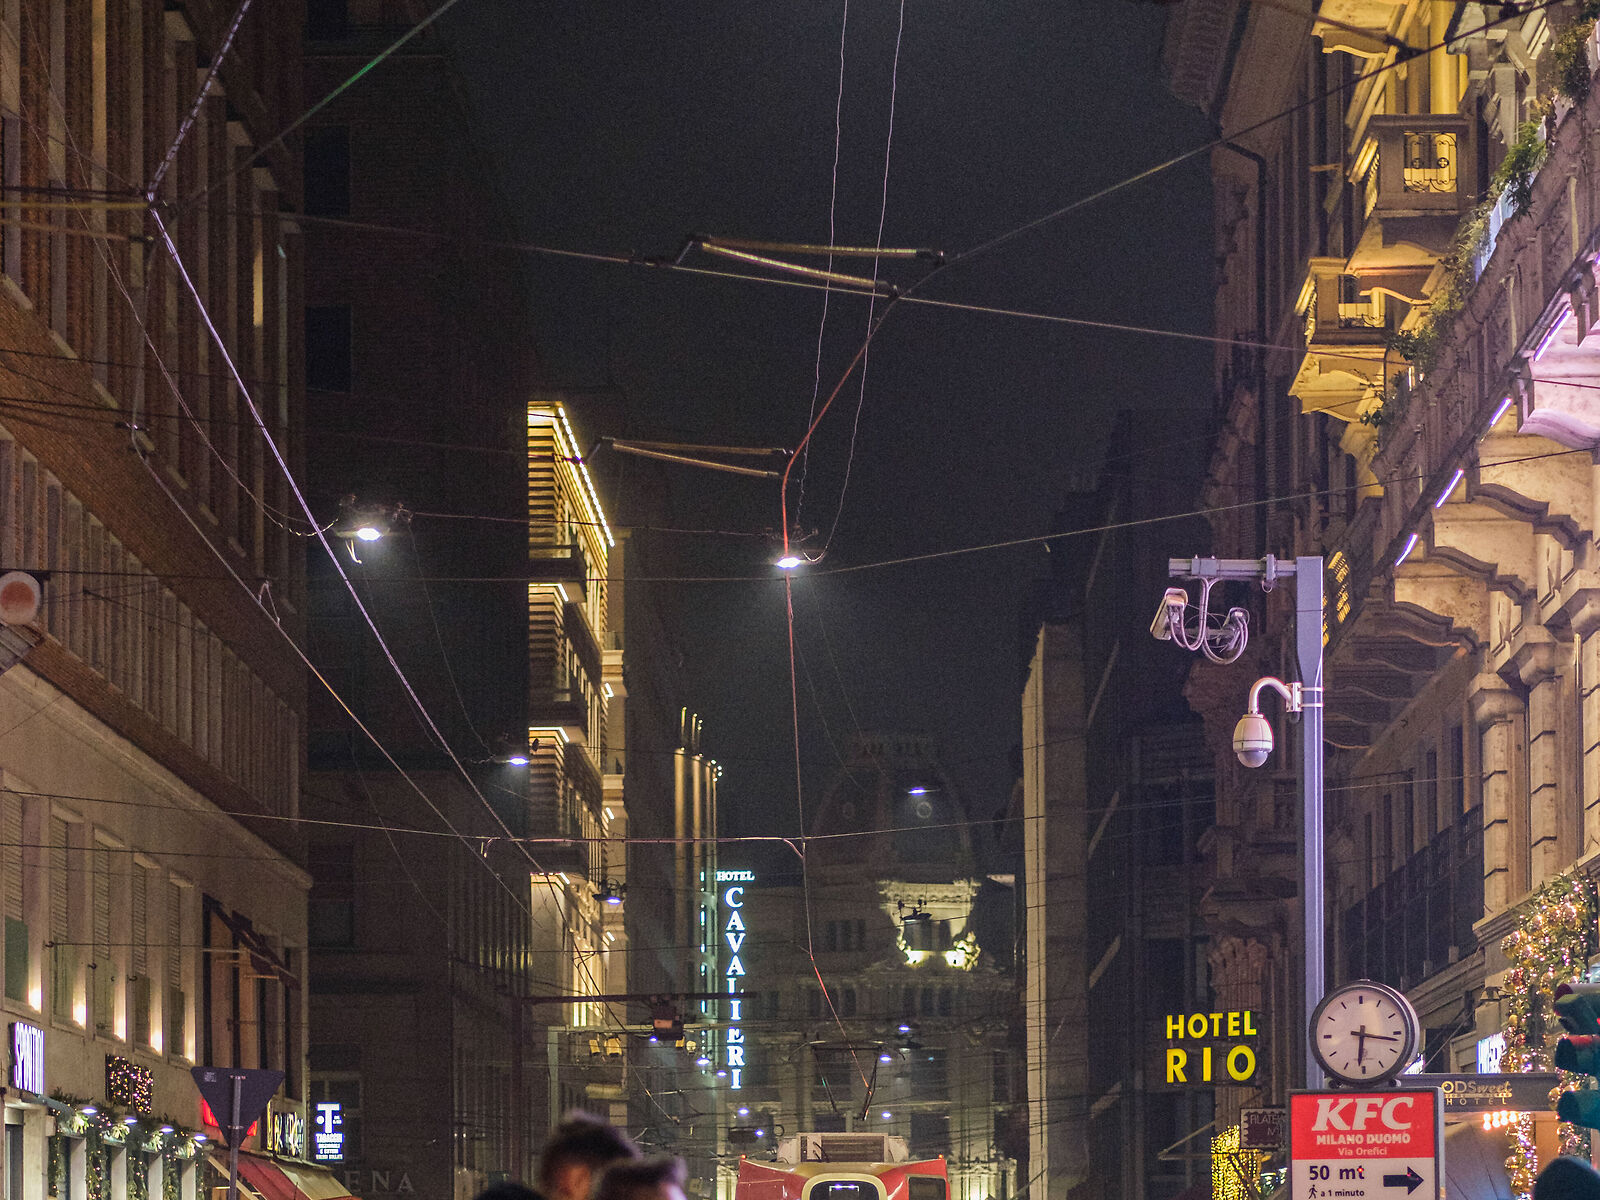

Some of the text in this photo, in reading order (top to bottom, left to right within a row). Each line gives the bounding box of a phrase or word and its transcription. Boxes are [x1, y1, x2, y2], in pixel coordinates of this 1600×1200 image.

[716, 871, 755, 881] HOTEL
[725, 886, 746, 1090] CAVALIERI
[1166, 1010, 1257, 1039] HOTEL
[1166, 1044, 1256, 1084] RIO
[1446, 1097, 1507, 1106] HOTEL
[1311, 1096, 1414, 1132] KFC
[1316, 1134, 1364, 1145] MILANO
[1338, 1147, 1387, 1156] Via Orefici
[1309, 1165, 1365, 1180] 50 mt
[1328, 1189, 1332, 1197] 1
[1335, 1188, 1365, 1197] minuto
